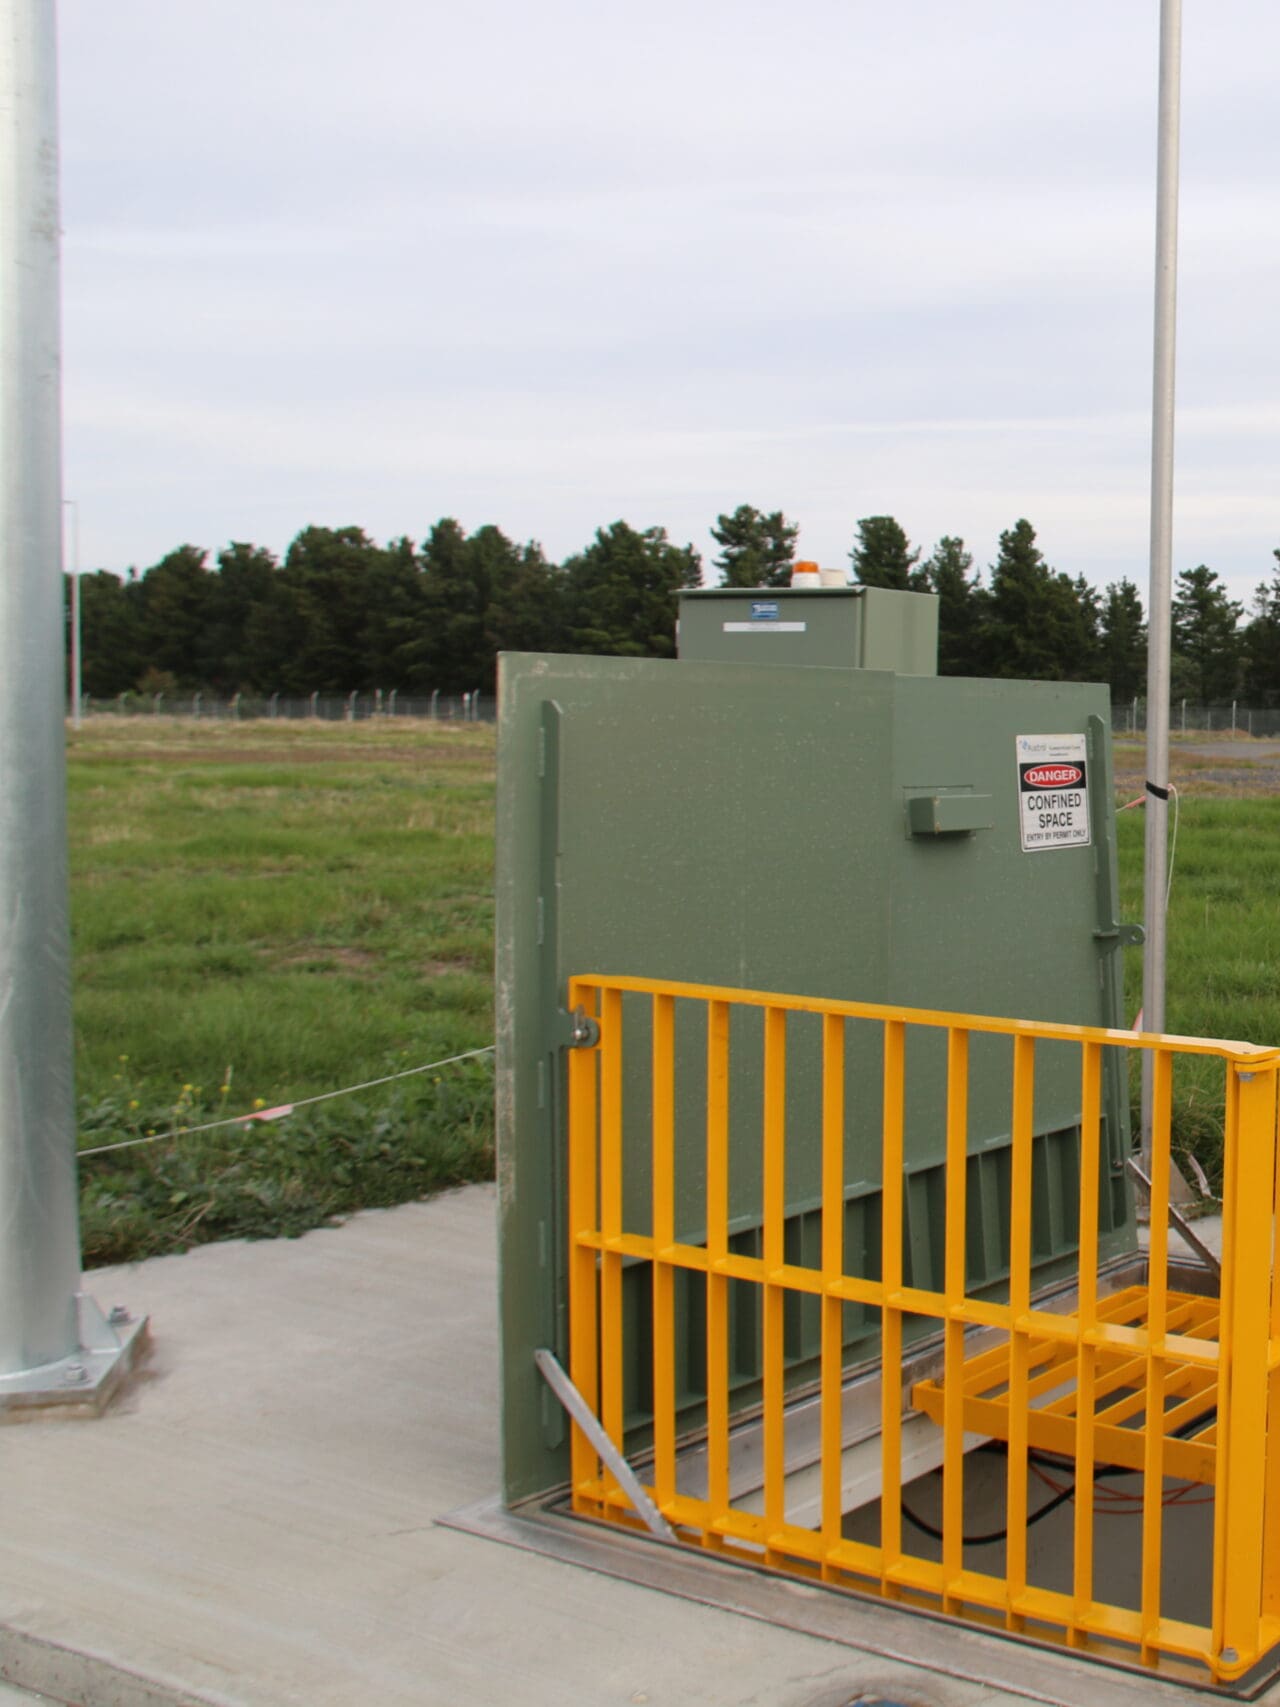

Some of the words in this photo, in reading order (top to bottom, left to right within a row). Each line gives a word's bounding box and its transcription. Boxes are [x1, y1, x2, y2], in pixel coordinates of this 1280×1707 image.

[1029, 769, 1077, 782] DANGER
[1028, 793, 1081, 810] CONFINED
[1039, 812, 1073, 828] SPACE
[1026, 833, 1044, 842] ENTRY
[1045, 832, 1051, 840] BY
[1052, 830, 1071, 839] PERMIT
[1072, 829, 1086, 838] ONLY
